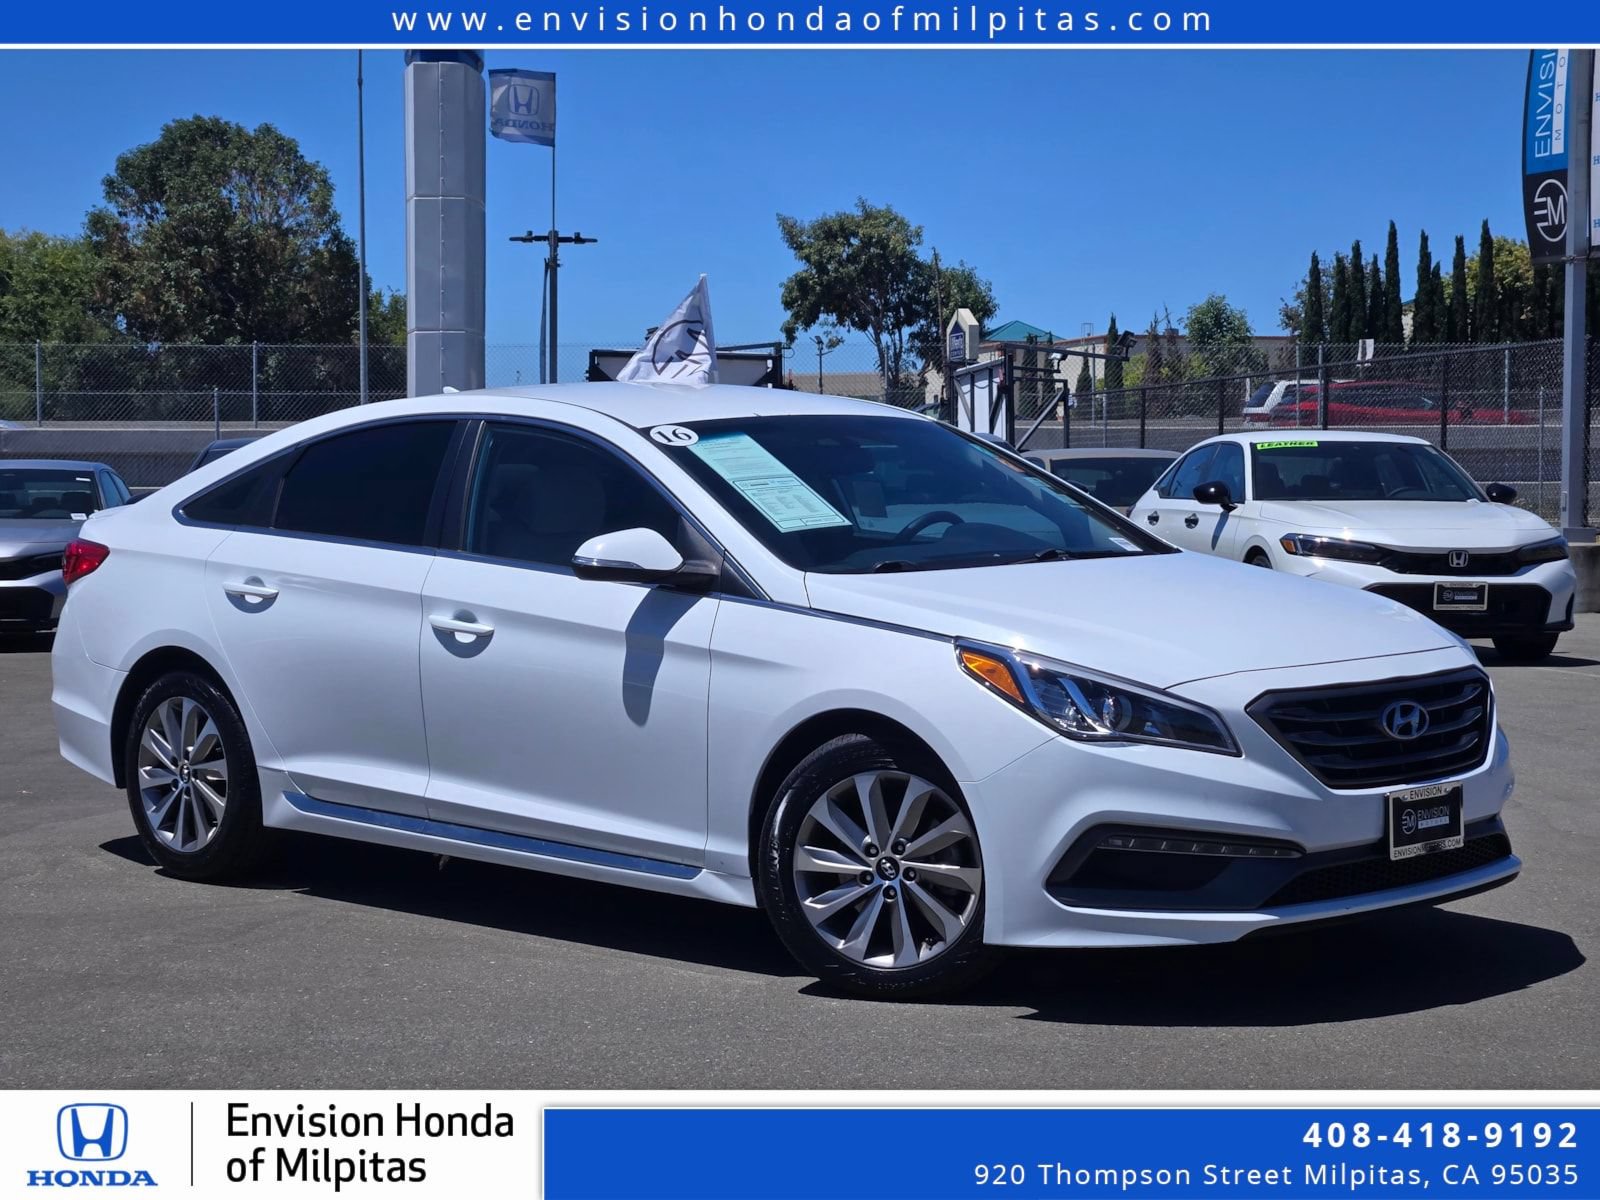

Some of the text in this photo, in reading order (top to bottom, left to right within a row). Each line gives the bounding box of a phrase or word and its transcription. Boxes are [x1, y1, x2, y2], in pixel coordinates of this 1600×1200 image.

[1535, 52, 1556, 158] ENVISI
[655, 427, 692, 443] 16
[1260, 441, 1314, 449] LEATHER
[1409, 786, 1442, 799] ENVISION
[1417, 806, 1450, 819] ENVISION
